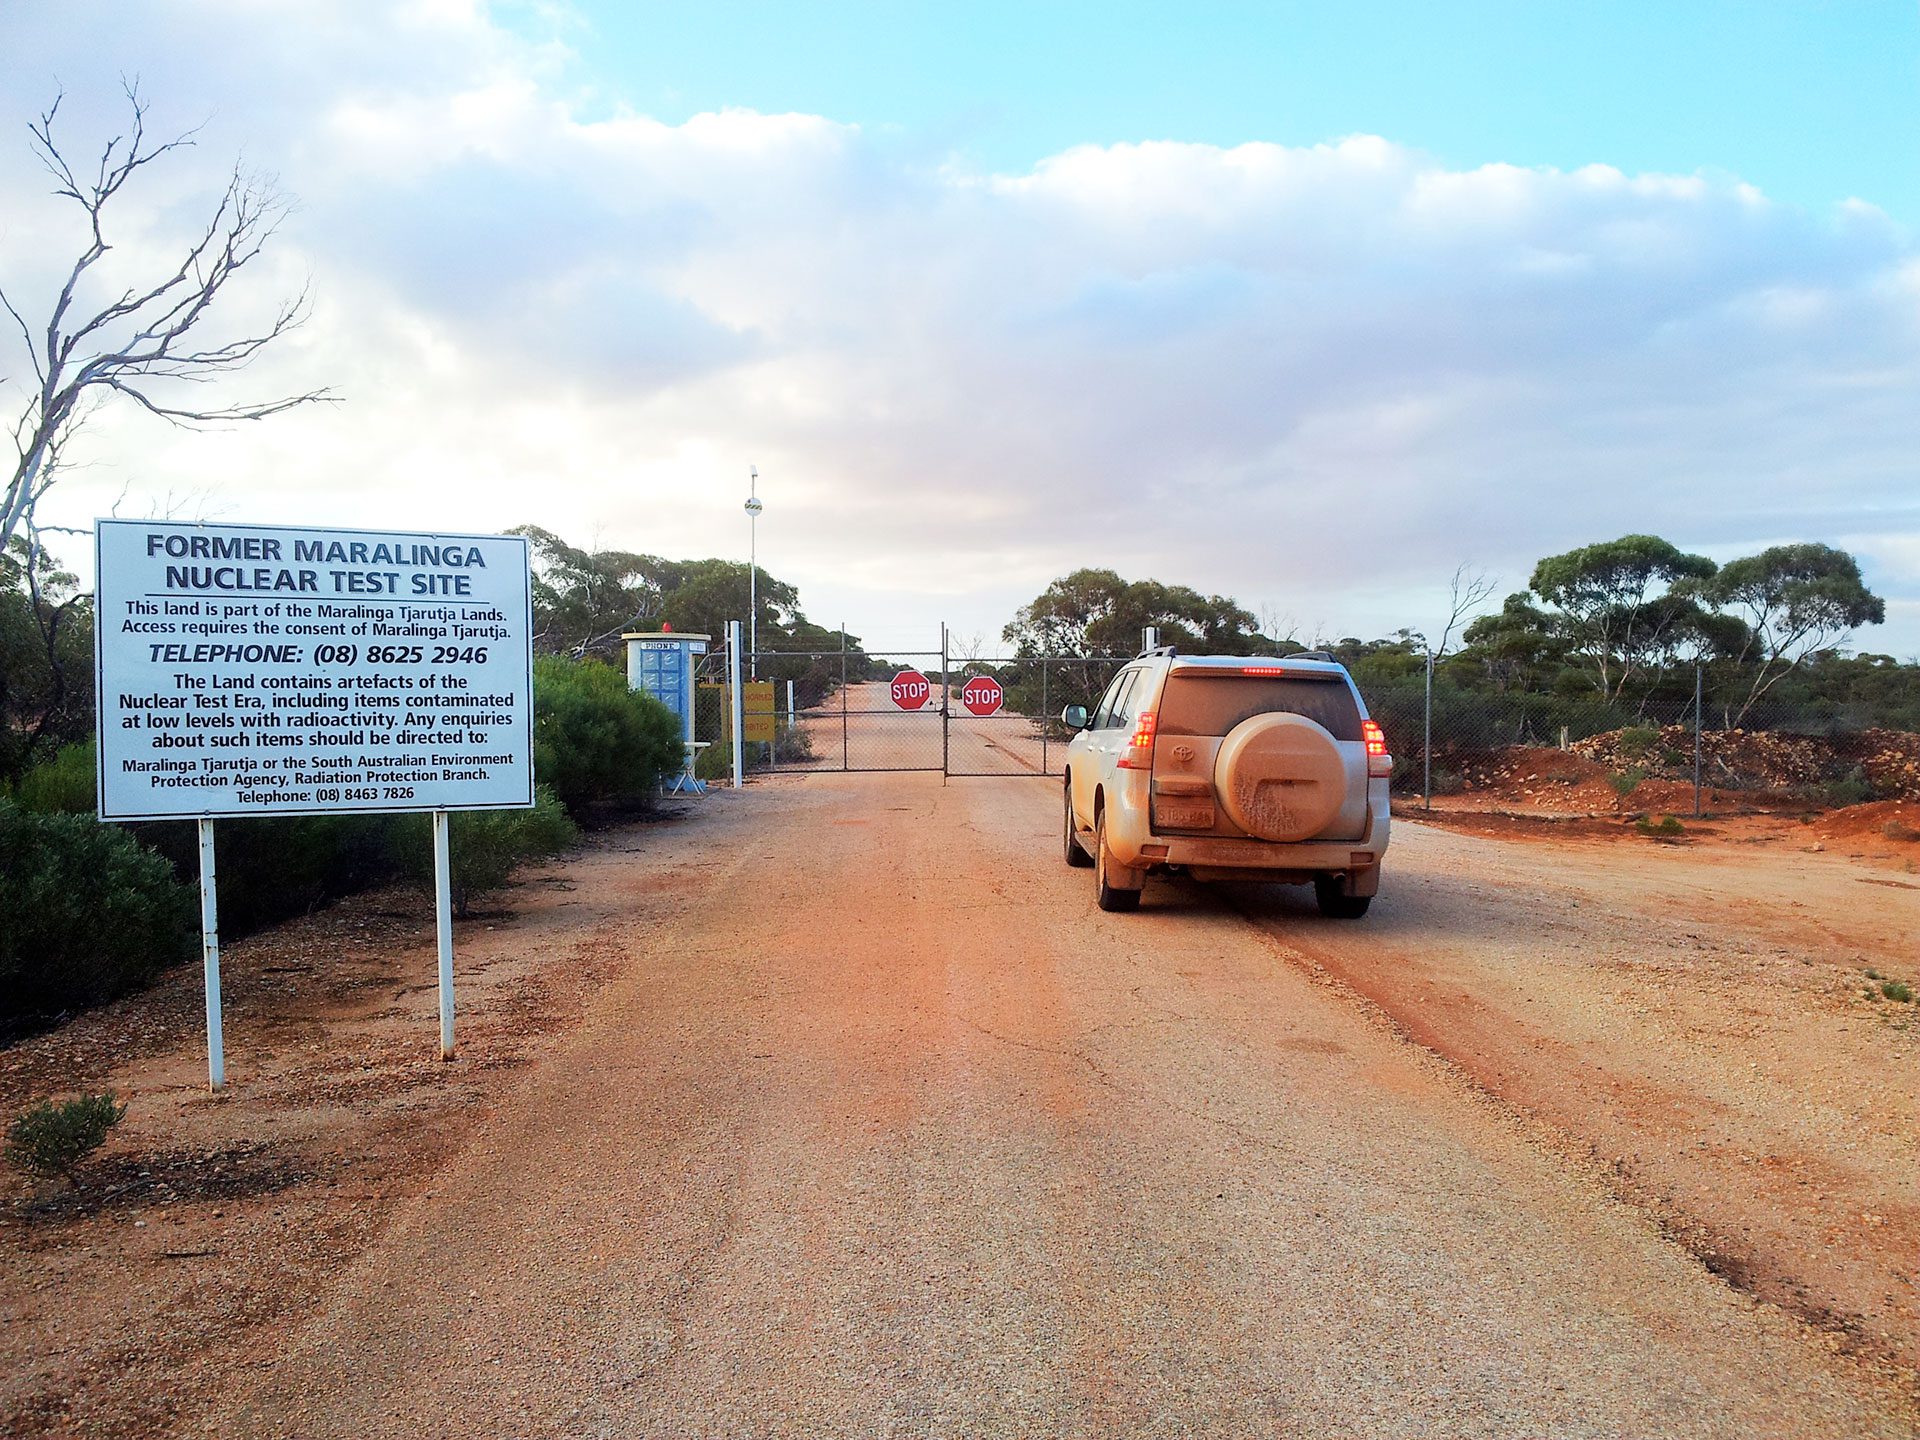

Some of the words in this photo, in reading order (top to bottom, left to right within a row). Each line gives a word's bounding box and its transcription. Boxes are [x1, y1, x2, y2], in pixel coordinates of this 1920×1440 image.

[147, 535, 283, 561] FORMER
[294, 540, 486, 567] MARALINGA
[166, 566, 320, 592] NUCLEAR
[329, 571, 400, 593] TEST
[411, 573, 471, 595] SITE
[125, 601, 158, 615] This
[164, 602, 199, 615] land
[205, 602, 218, 616] is
[224, 604, 259, 619] part
[264, 604, 281, 617] of
[285, 604, 312, 617] the
[318, 605, 394, 622] Maralinga
[398, 606, 456, 623] Tjarutja
[461, 608, 507, 621] Lands.
[121, 619, 176, 633] Access
[182, 621, 248, 636] requires
[252, 621, 280, 634] the
[285, 623, 346, 635] consent
[351, 622, 367, 636] of
[373, 623, 447, 639] Maralinga
[451, 624, 511, 640] Tjarutja.
[149, 644, 304, 663] TELEPHONE:
[314, 645, 358, 665] (08)
[366, 646, 424, 663] 8625
[431, 646, 488, 664] 2946
[173, 673, 206, 689] The
[212, 673, 255, 689] Land
[260, 674, 332, 689] contains
[337, 674, 413, 689] artefacts
[419, 674, 436, 689] of
[440, 674, 467, 689] the
[892, 682, 928, 700] STOP
[965, 689, 1000, 705] STOP
[119, 693, 188, 709] Nuclear
[193, 694, 228, 708] Test
[234, 693, 266, 710] Era,
[272, 692, 349, 710] including
[355, 692, 400, 707] items
[405, 692, 514, 707] contaminated
[122, 714, 141, 729] at
[147, 712, 180, 728] low
[186, 712, 235, 728] levels
[240, 712, 281, 727] with
[287, 711, 398, 728] radioactivity.
[404, 712, 436, 728] Any
[441, 711, 513, 728] enquiries
[152, 732, 205, 748] about
[210, 731, 250, 747] such
[256, 731, 304, 747] items
[309, 730, 364, 746] should
[370, 730, 390, 745] be
[396, 729, 463, 744] directed
[467, 730, 488, 744] to:
[122, 758, 196, 772] Maralinga
[201, 757, 257, 772] Tjarutja
[262, 760, 278, 769] or
[282, 756, 307, 769] the
[311, 755, 352, 768] South
[357, 754, 426, 767] Australian
[431, 753, 514, 766] Environment
[151, 773, 228, 788] Protection
[233, 773, 290, 786] Agency,
[295, 771, 362, 784] Radiation
[367, 769, 438, 782] Protection
[443, 768, 490, 781] Branch.
[236, 790, 311, 803] Telephone:
[316, 788, 340, 803] (08)
[344, 788, 378, 800] 8463
[383, 787, 414, 799] 7826
